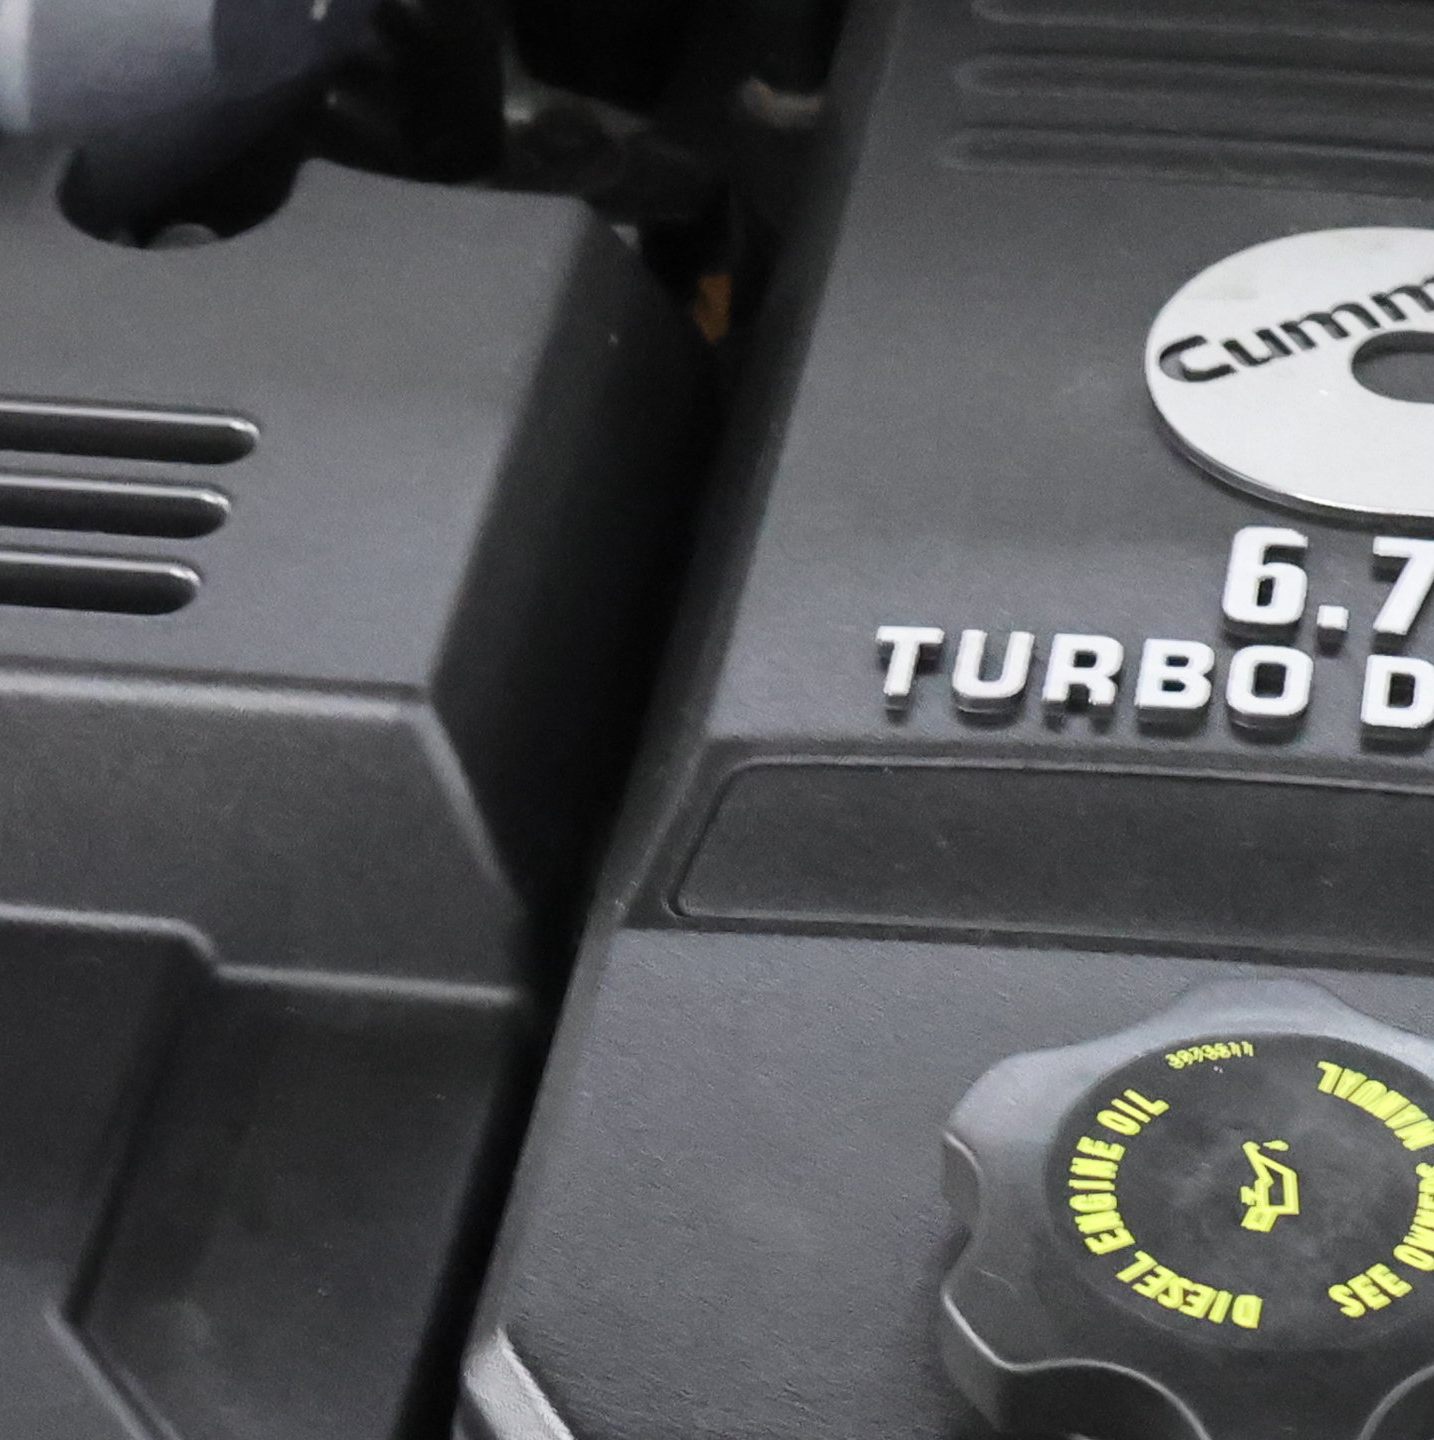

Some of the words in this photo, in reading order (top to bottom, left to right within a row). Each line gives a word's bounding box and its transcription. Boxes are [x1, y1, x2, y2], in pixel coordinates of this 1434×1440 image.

[875, 624, 1314, 727] TURBO
[1095, 1087, 1171, 1137] OIL
[1067, 1136, 1136, 1256] ENGINE
[1116, 1249, 1264, 1330] DIESEL
[1326, 1262, 1414, 1320] SEE
